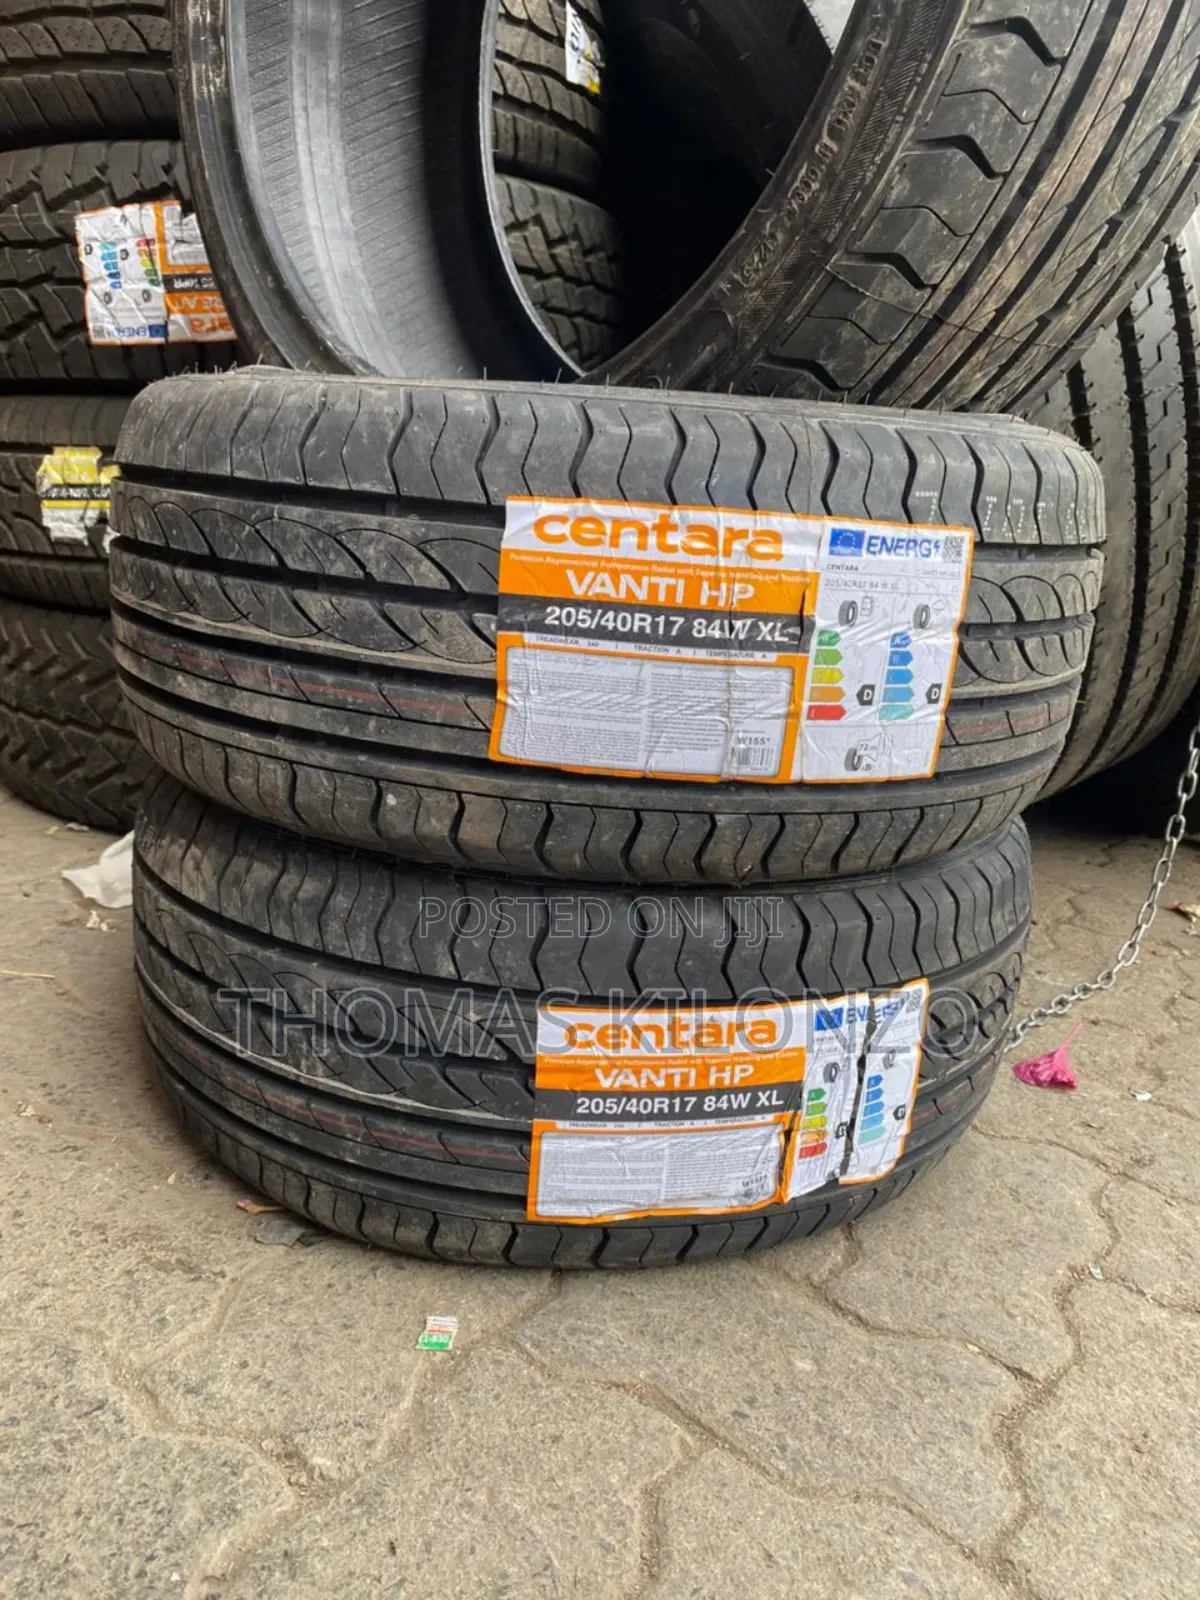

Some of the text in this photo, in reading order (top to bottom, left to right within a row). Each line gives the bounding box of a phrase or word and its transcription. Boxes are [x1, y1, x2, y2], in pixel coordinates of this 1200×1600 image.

[532, 513, 785, 562] centara
[565, 569, 756, 609] VANTI HP
[544, 605, 790, 642] 205/40R17 84W XL
[564, 1015, 777, 1050] centara
[594, 1064, 755, 1089] VANTI HP
[575, 1088, 785, 1115] 205/40R17 84W XL
